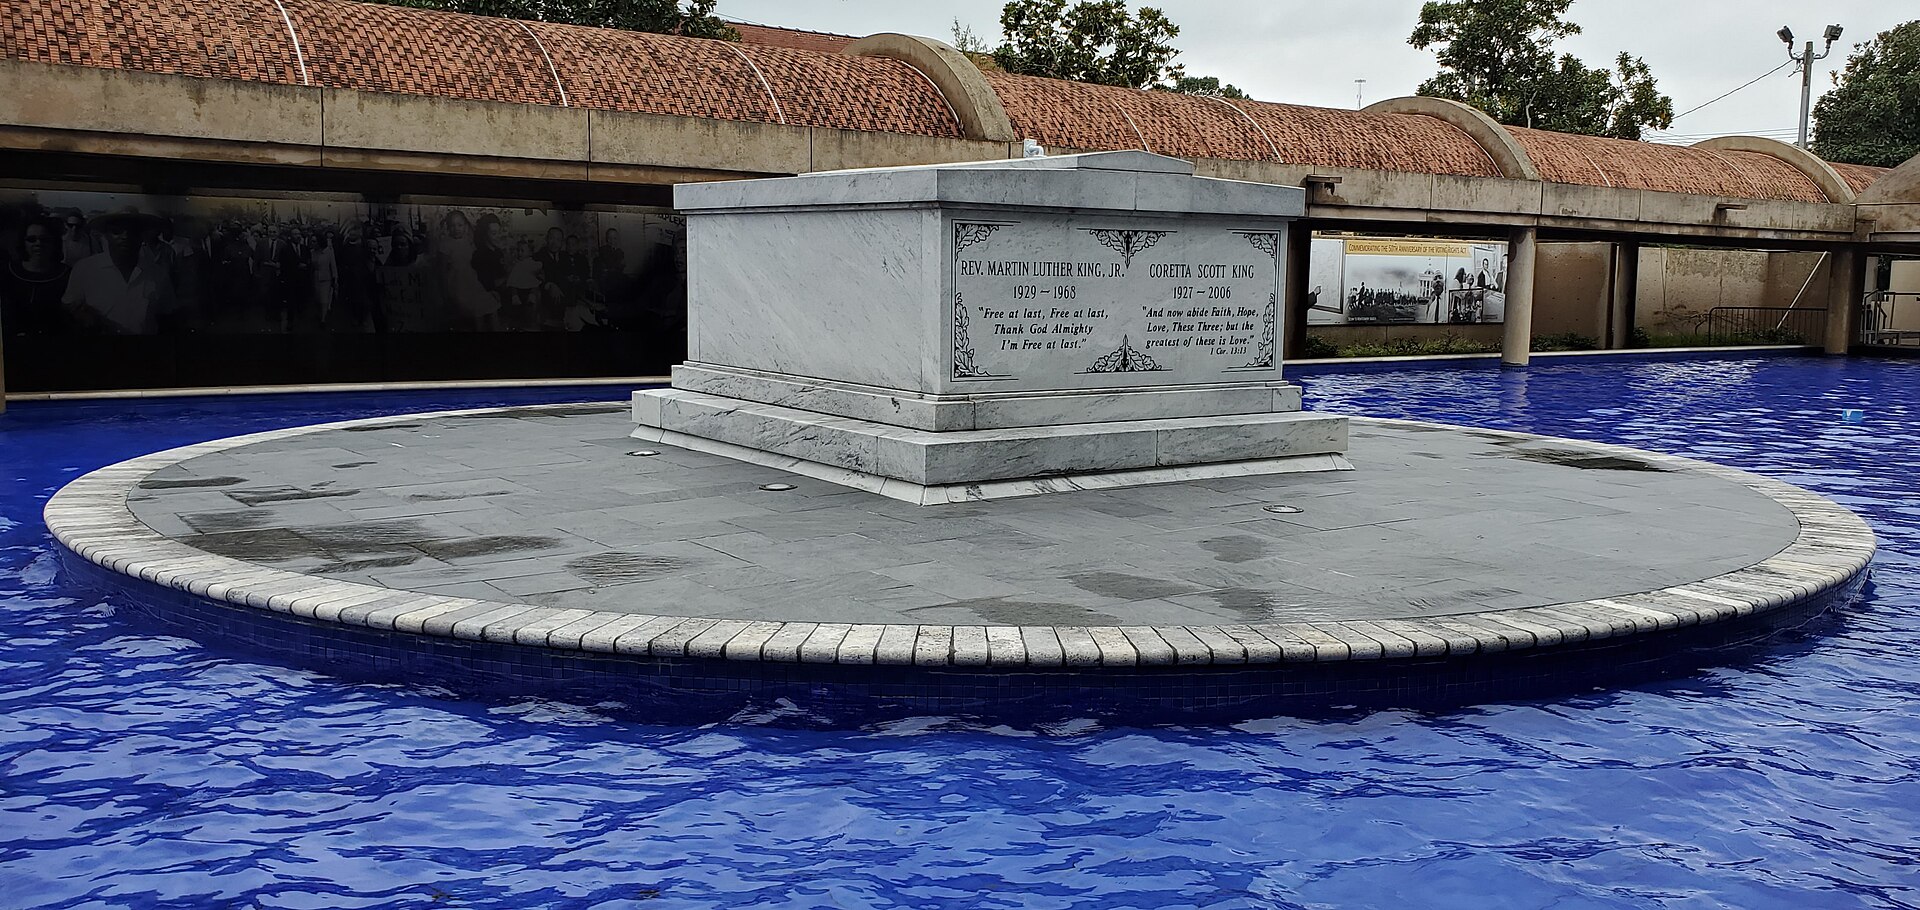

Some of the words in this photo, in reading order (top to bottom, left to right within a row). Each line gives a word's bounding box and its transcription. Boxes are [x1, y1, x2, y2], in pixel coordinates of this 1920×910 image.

[1348, 244, 1380, 252] COMMEMORATING
[1398, 245, 1422, 253] ANNIVERSARY
[961, 261, 983, 276] REV.
[988, 262, 1029, 276] MARTIN
[1033, 262, 1073, 276] LUTHER
[1077, 263, 1105, 277] KING,
[1108, 263, 1125, 277] JR.
[1150, 264, 1191, 278] CORETTA
[1198, 264, 1226, 278] SCOTT
[1232, 265, 1254, 278] KING
[1013, 285, 1036, 299] 1929
[1054, 286, 1076, 299] 1968
[1173, 286, 1193, 299] 1927
[1208, 286, 1231, 299] 2006
[979, 306, 1004, 318] "Free
[1009, 310, 1018, 318] at
[1024, 308, 1045, 319] last,
[1050, 308, 1069, 318] Free
[1074, 309, 1083, 318] at
[1088, 308, 1108, 319] last,
[1142, 306, 1163, 317] "And
[1187, 308, 1208, 317] abide
[1211, 307, 1234, 317] Faith,
[1237, 307, 1258, 317] Hope,
[994, 324, 1023, 334] Thank
[1030, 324, 1047, 334] God
[1052, 324, 1093, 335] Almighty
[1147, 322, 1168, 332] Love,
[1172, 322, 1194, 332] These
[1198, 322, 1222, 332] Three;
[1226, 322, 1238, 330] but
[1242, 321, 1253, 330] the
[1001, 339, 1018, 350] I'm
[1022, 339, 1042, 350] Free
[1047, 341, 1056, 349] at
[1146, 338, 1179, 349] greatest
[1183, 336, 1192, 347] of
[1196, 336, 1216, 346] these
[1219, 336, 1225, 345] is
